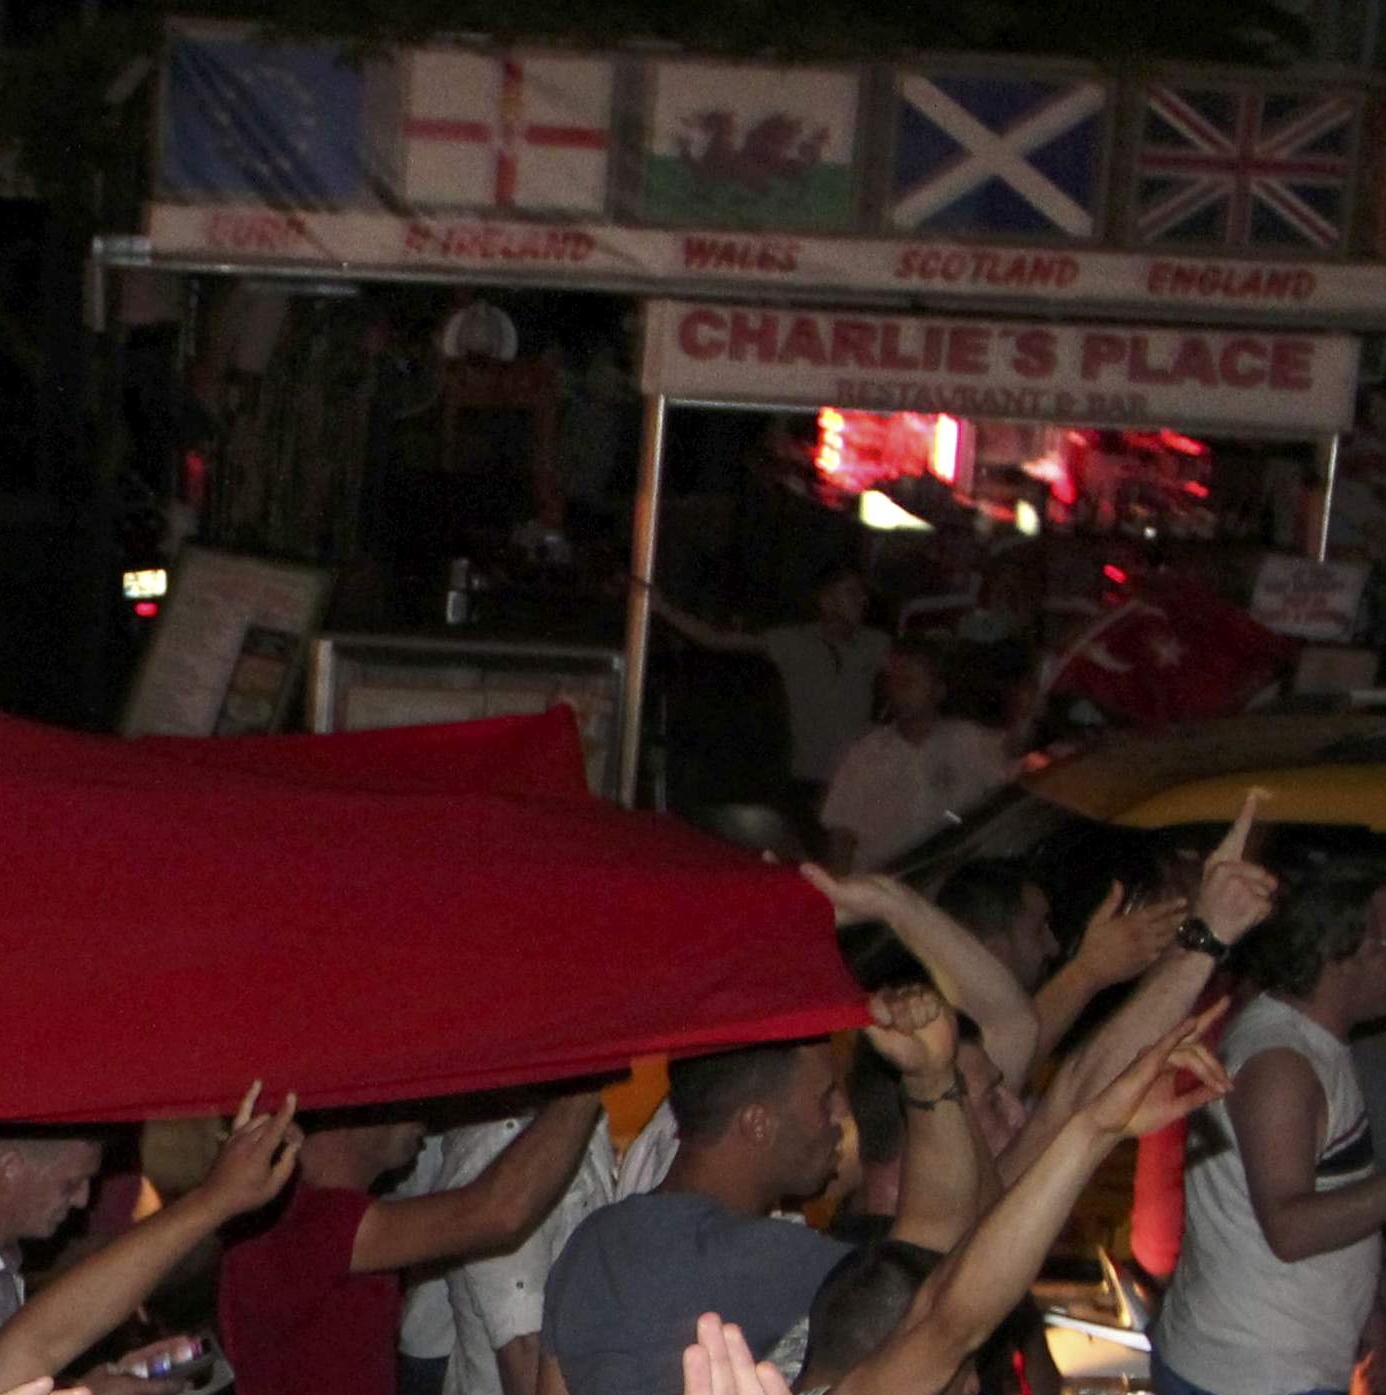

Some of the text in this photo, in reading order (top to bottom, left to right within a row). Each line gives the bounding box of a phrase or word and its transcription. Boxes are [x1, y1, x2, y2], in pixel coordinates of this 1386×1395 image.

[684, 236, 799, 272] WALES
[894, 250, 1079, 288] SCOTLAND
[1148, 261, 1317, 299] ENGLAND
[1081, 332, 1316, 392] PLACE
[836, 378, 1043, 413] RESTAURANT
[1085, 391, 1150, 420] BAR
